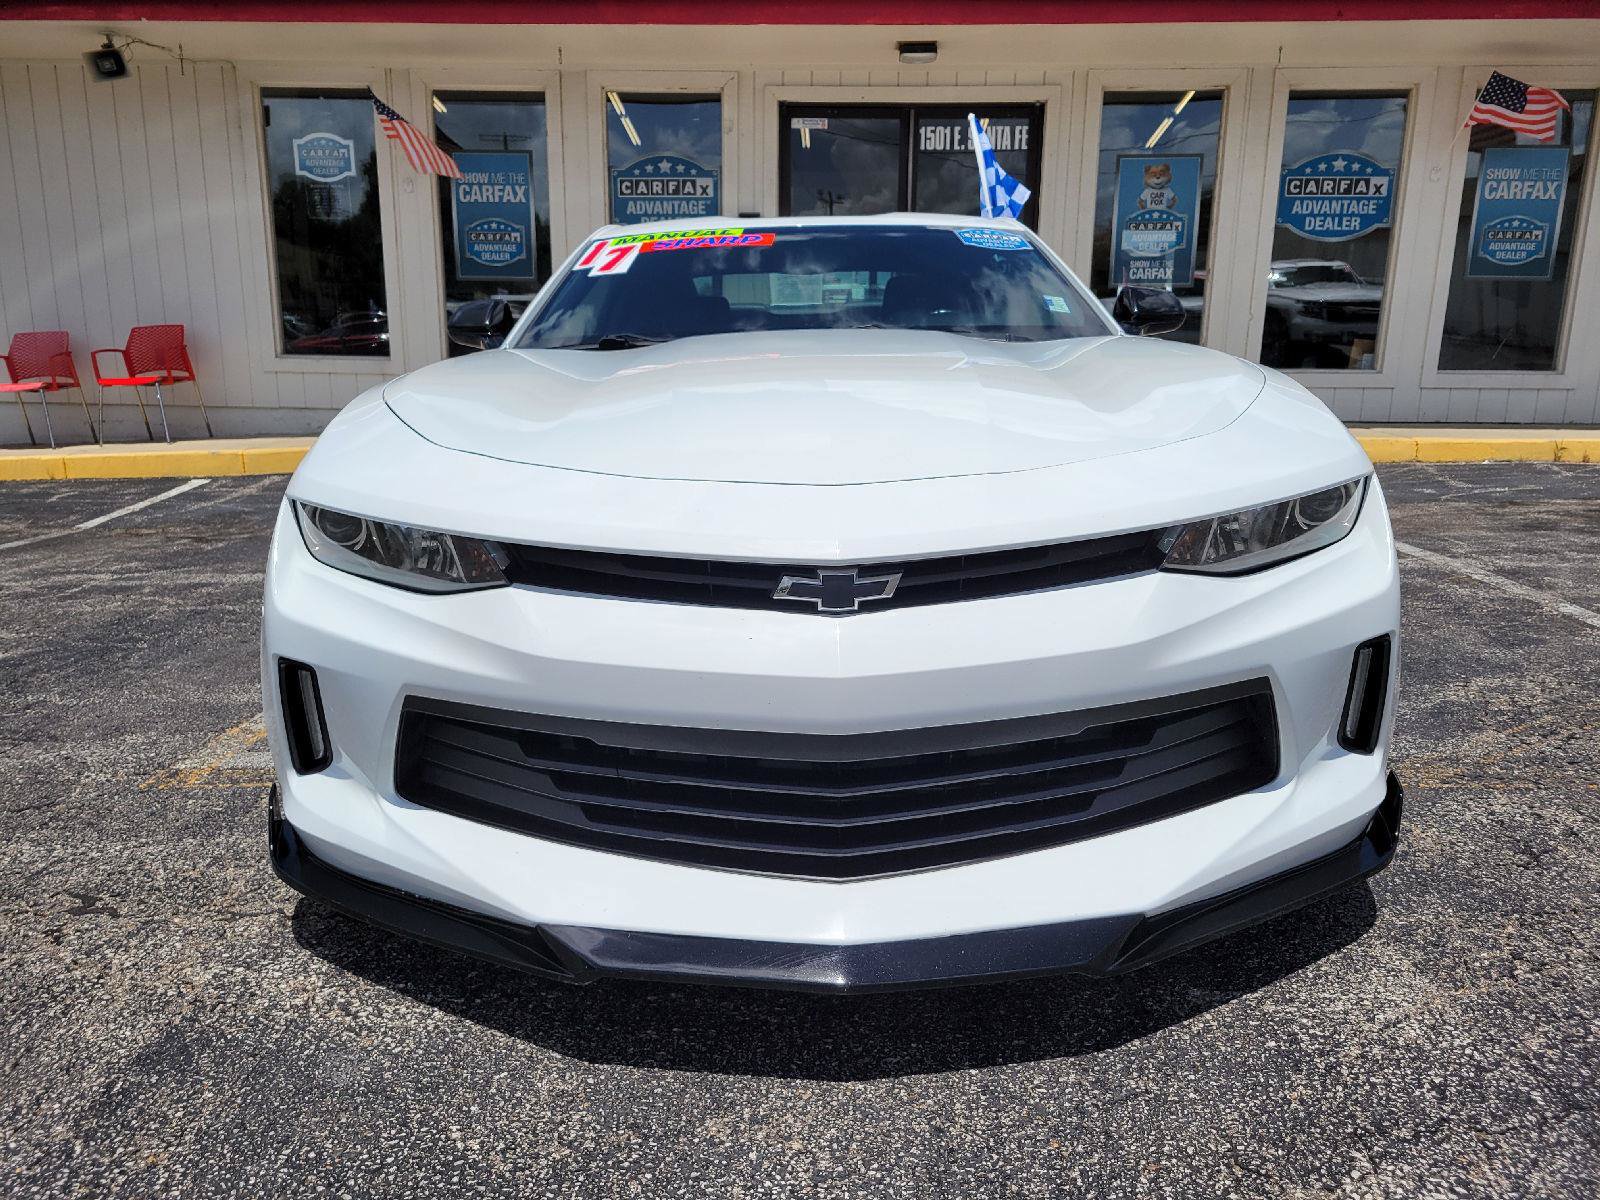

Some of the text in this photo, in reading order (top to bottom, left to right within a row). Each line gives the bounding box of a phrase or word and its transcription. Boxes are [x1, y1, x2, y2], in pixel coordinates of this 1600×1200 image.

[919, 126, 1029, 150] 1501 E. SNTA FE
[491, 173, 505, 184] ME
[508, 173, 525, 184] THE
[1486, 168, 1561, 180] SHOW ME THE
[460, 184, 526, 203] CARFAX
[620, 180, 711, 196] CARFAX
[1288, 179, 1385, 196] CARFAX
[1484, 181, 1559, 200] CARFAX
[1150, 191, 1165, 199] CAR
[626, 200, 707, 215] ADVANTAGE
[1291, 200, 1378, 215] ADVANTAGE
[1130, 223, 1181, 231] CARFAX
[1304, 216, 1361, 231] DEALER
[617, 228, 734, 245] MANUAL
[652, 234, 763, 250] SHARP
[1488, 231, 1542, 240] CARFAX
[474, 243, 517, 252] ADVANTAGE
[1489, 242, 1536, 251] ADVANTAGE
[481, 252, 511, 261] DEALER
[578, 240, 636, 273] 17
[1495, 251, 1527, 259] DEALER
[1130, 259, 1150, 268] SHOW
[1130, 268, 1173, 280] CARFAX
